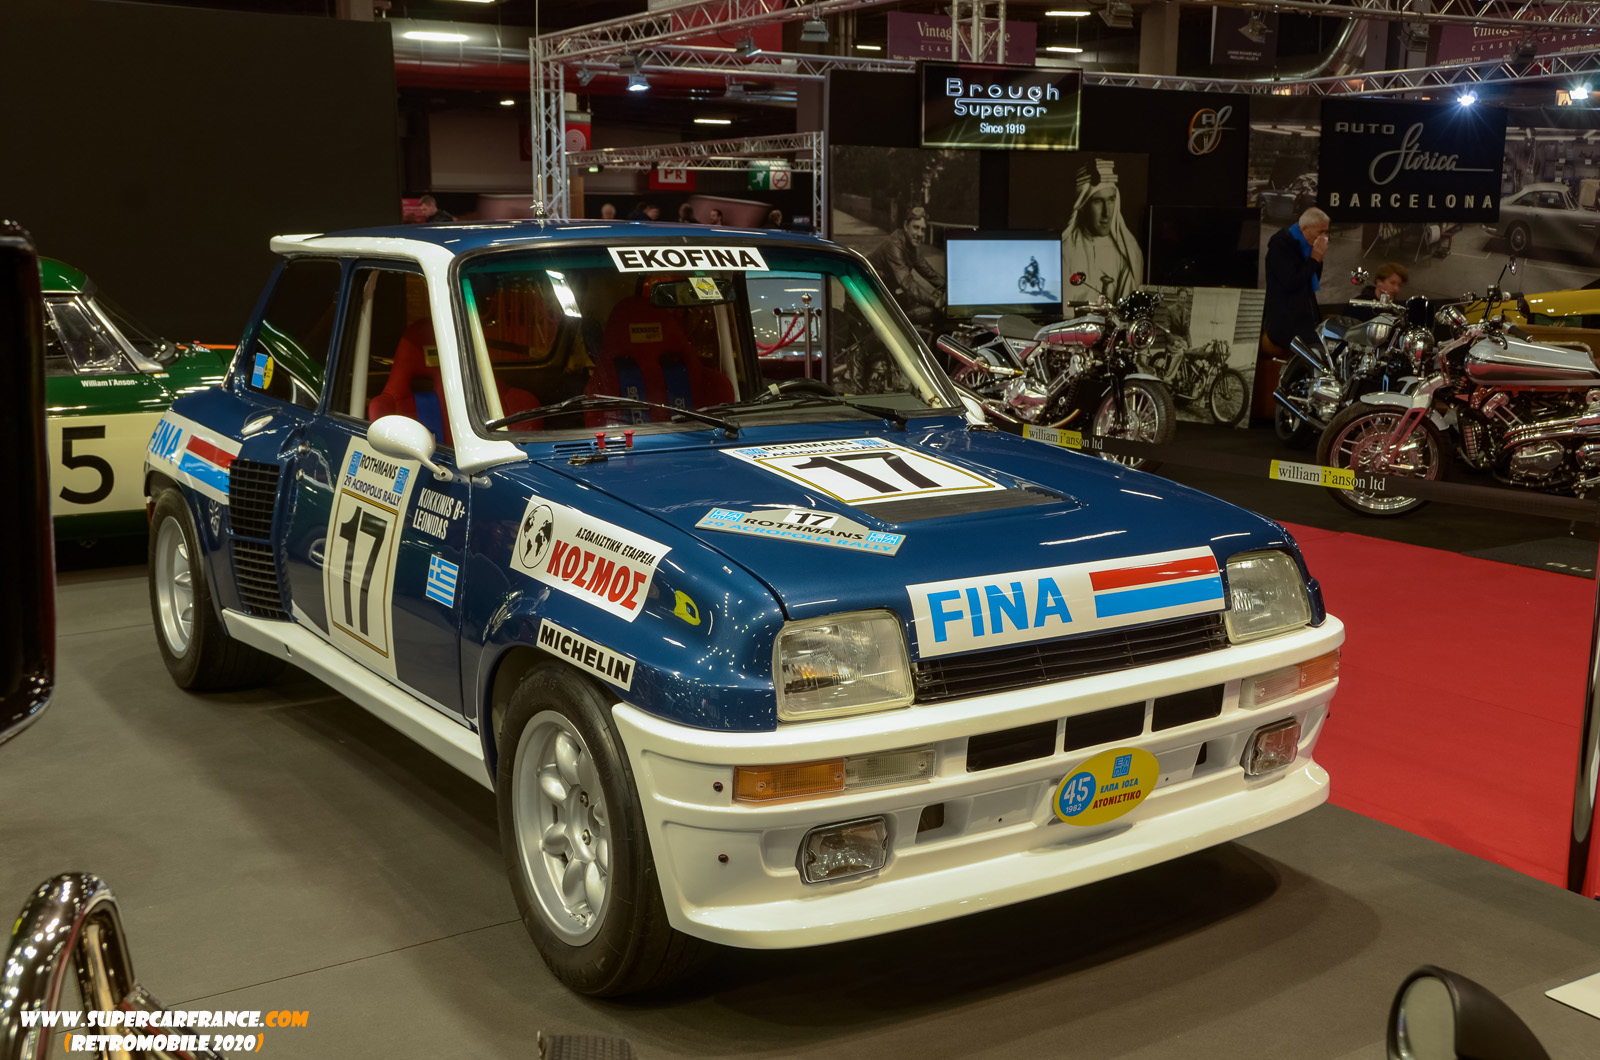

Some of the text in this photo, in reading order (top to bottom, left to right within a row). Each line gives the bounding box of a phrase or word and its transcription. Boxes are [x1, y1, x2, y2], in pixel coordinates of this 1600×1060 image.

[917, 21, 953, 40] Vintag
[946, 77, 1060, 101] Brough
[954, 97, 1048, 119] Superior
[980, 122, 1026, 134] Since 1919
[1335, 121, 1395, 135] AUTO
[1368, 122, 1494, 186] Storica
[1329, 192, 1493, 209] BARCELONA
[616, 249, 761, 269] EKOFINA
[81, 379, 108, 387] William
[761, 440, 854, 452] ROTHMANS
[1029, 428, 1103, 450] william i'anson ltd
[772, 446, 850, 457] ACROPOLIS
[59, 425, 114, 504] 5
[359, 454, 399, 480] ROTHMANS
[792, 451, 942, 493] 17
[1279, 466, 1385, 491] william i'anson ltd
[344, 475, 352, 487] 29
[351, 478, 383, 500] ACROPOLIS
[382, 490, 402, 507] RALLY
[417, 487, 455, 518] KOKKINIS
[412, 508, 449, 540] LEONIDAS
[743, 518, 864, 540] ROTHMANS
[794, 512, 834, 526] 17
[728, 525, 836, 544] ACROPOLIS
[836, 539, 893, 552] RALLY
[339, 505, 387, 636] 17
[546, 539, 647, 611] ΚΟΣΜΟΣ
[927, 577, 1073, 643] FINA
[540, 624, 631, 684] MICHELIN
[1064, 776, 1091, 804] 45
[1065, 803, 1082, 814] 1982
